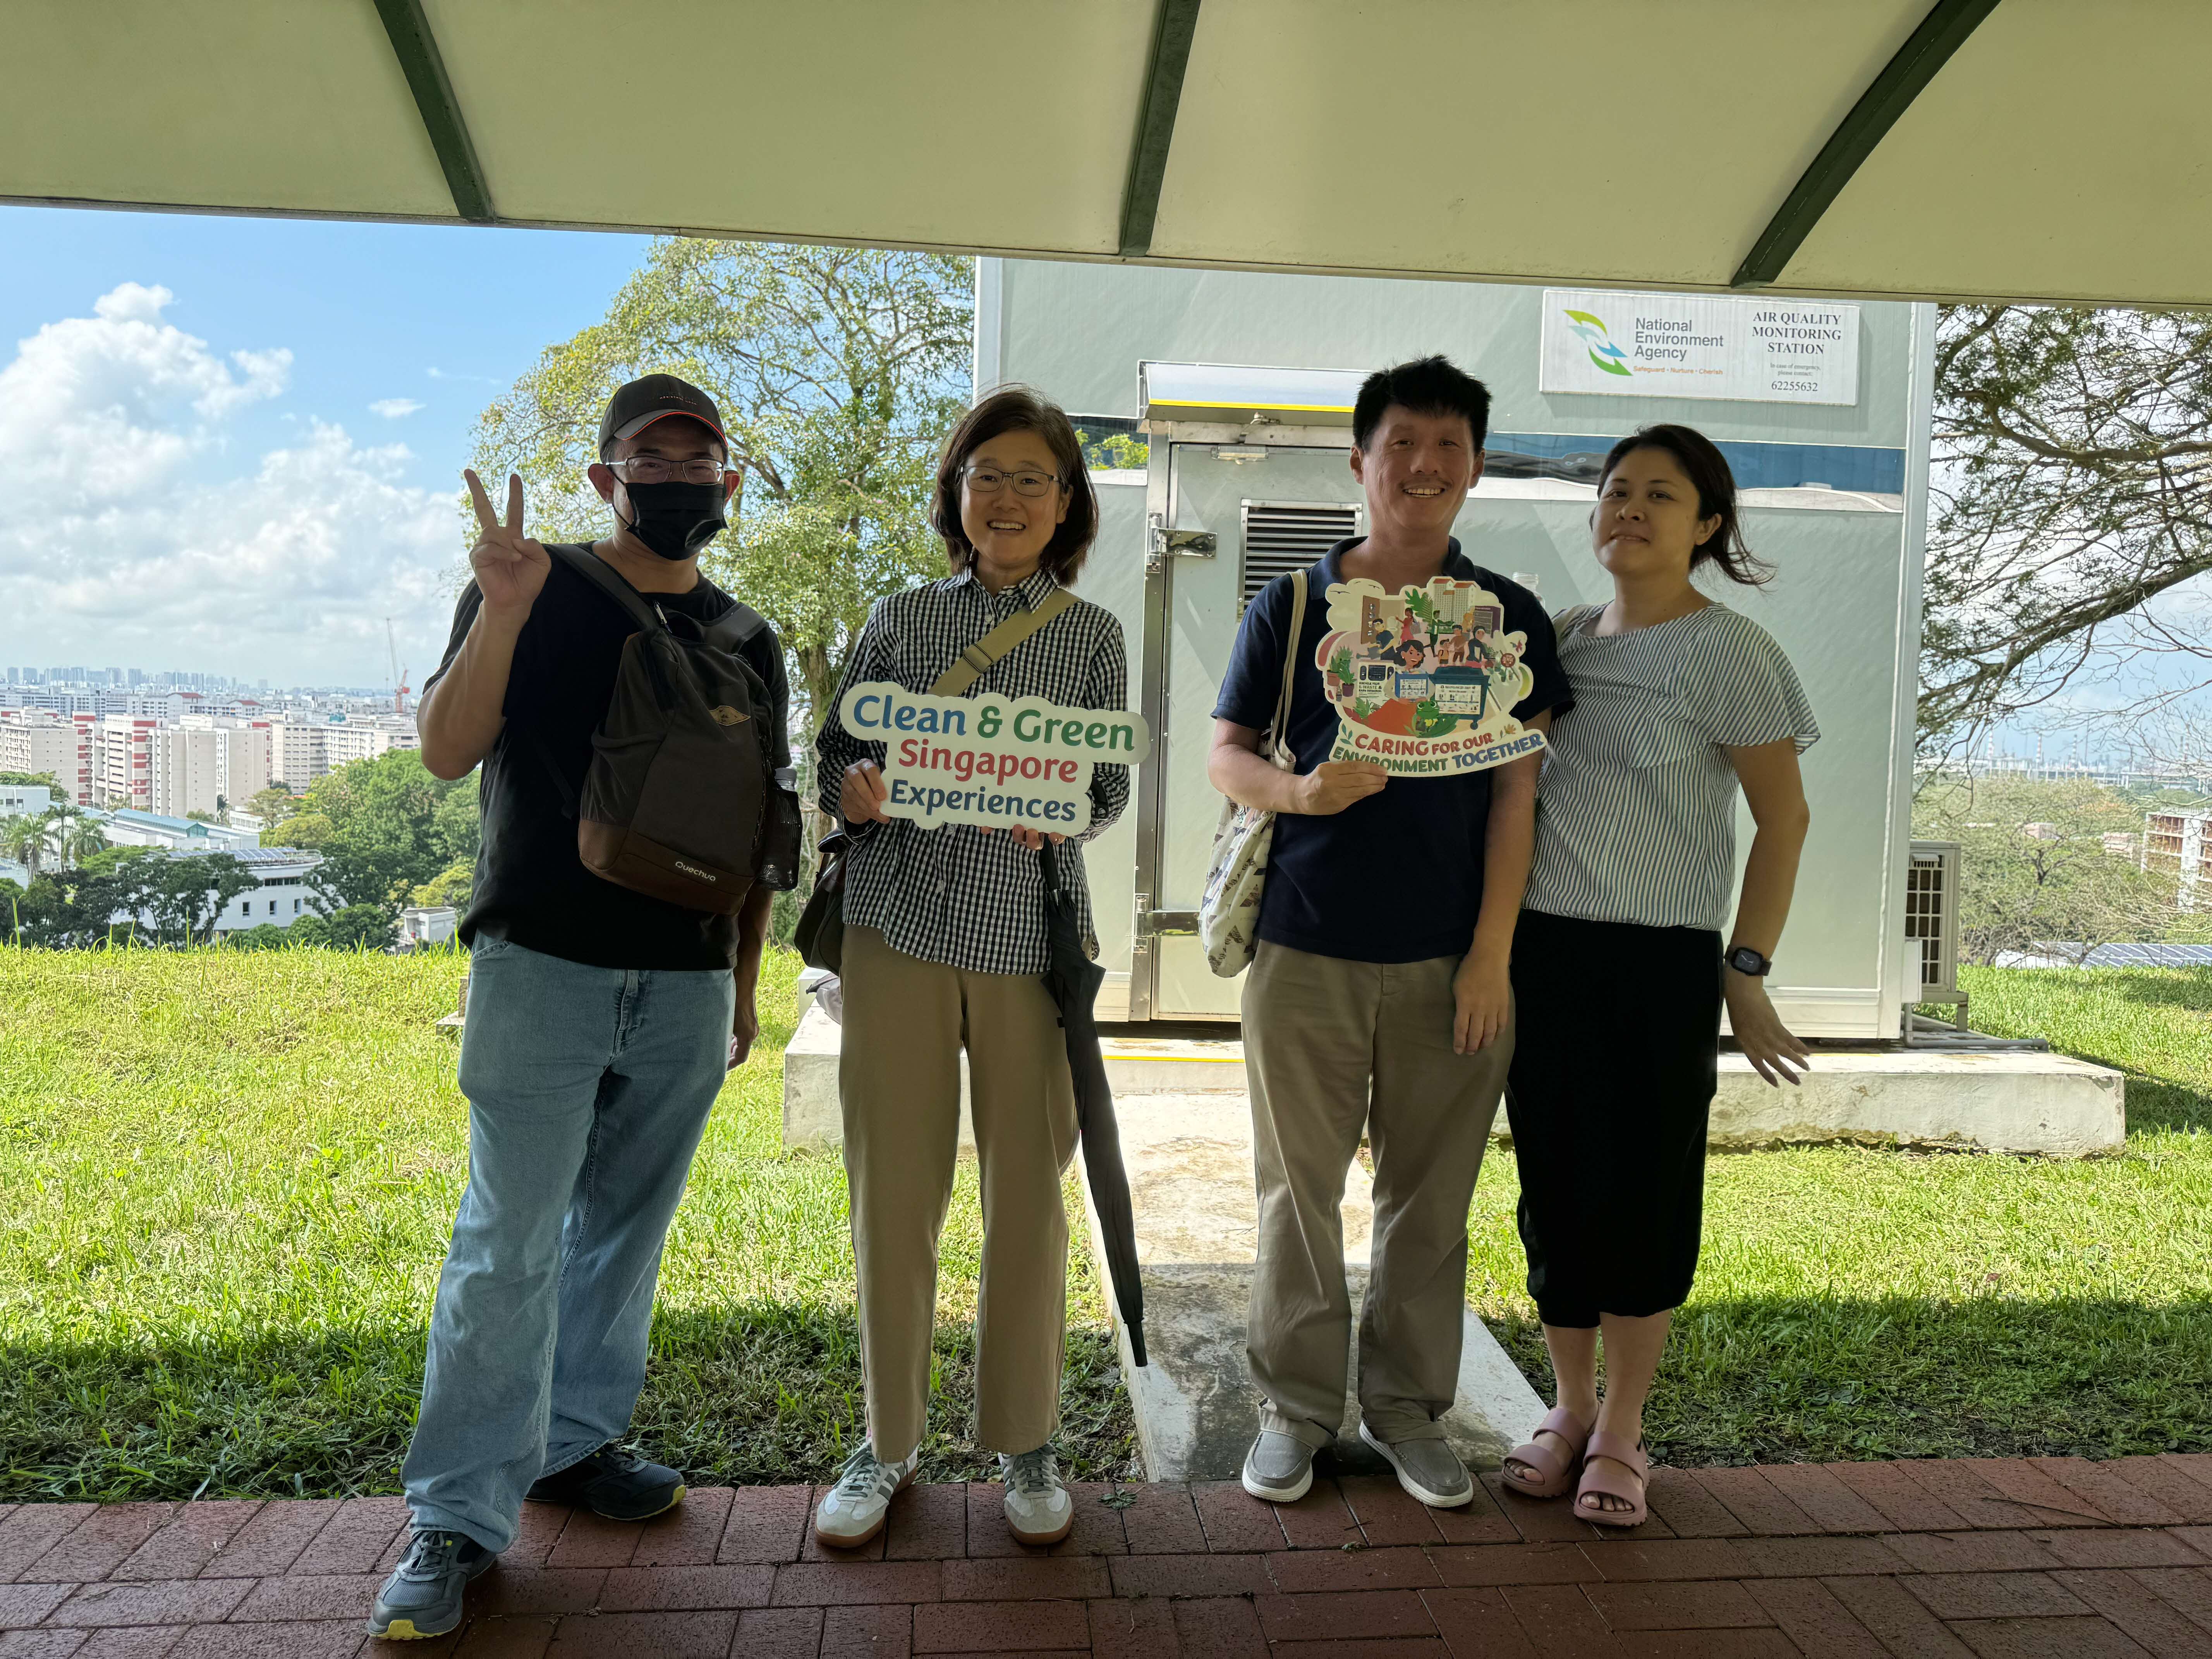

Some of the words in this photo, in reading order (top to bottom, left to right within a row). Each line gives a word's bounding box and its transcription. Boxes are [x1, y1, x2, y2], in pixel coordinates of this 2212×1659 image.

[1635, 318, 1692, 332] National
[1753, 312, 1777, 322] AIR
[1781, 313, 1841, 325] QUALITY
[1635, 331, 1724, 347] Environment
[1752, 326, 1841, 340] MONITORING
[1634, 345, 1687, 362] Agency
[1767, 342, 1824, 354] STATION
[1771, 381, 1818, 392] 62255632
[854, 694, 966, 736] Clean
[977, 706, 1003, 738] &
[1013, 709, 1135, 751] Green
[1355, 733, 1429, 756] CARING
[1432, 741, 1460, 755] FOR
[1463, 732, 1494, 750] OUR
[1452, 733, 1544, 768] TOGETHER
[898, 738, 1078, 786] Singapore
[890, 779, 1076, 822] Experiences
[675, 861, 716, 881] Quechua
